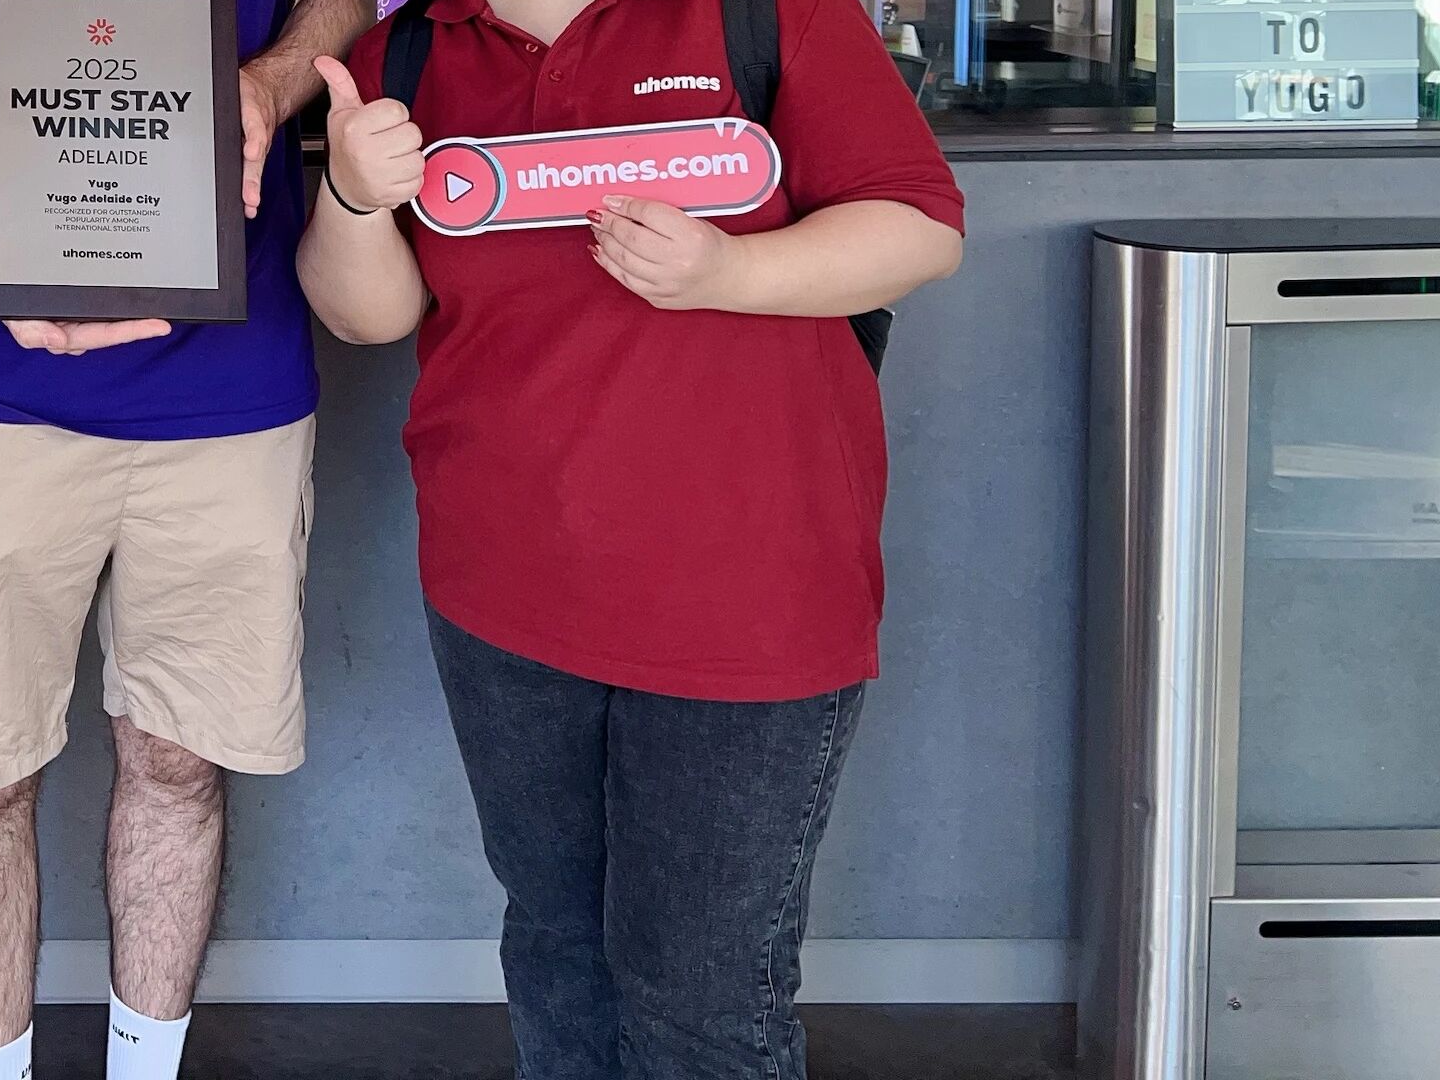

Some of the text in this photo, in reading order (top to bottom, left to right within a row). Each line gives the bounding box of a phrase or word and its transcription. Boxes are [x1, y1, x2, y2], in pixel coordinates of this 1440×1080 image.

[1267, 18, 1320, 54] TO
[67, 58, 137, 81] 2025
[634, 75, 720, 95] uhomes
[1241, 75, 1365, 112] YUGO
[11, 88, 192, 112] MUST STAY
[31, 116, 170, 140] WINNER
[58, 149, 148, 166] ADELAIDE
[516, 151, 749, 190] uhomes.com
[88, 180, 118, 191] Yugo
[47, 194, 160, 206] Yugo Adelaide City
[63, 249, 142, 259] uhomes.com
